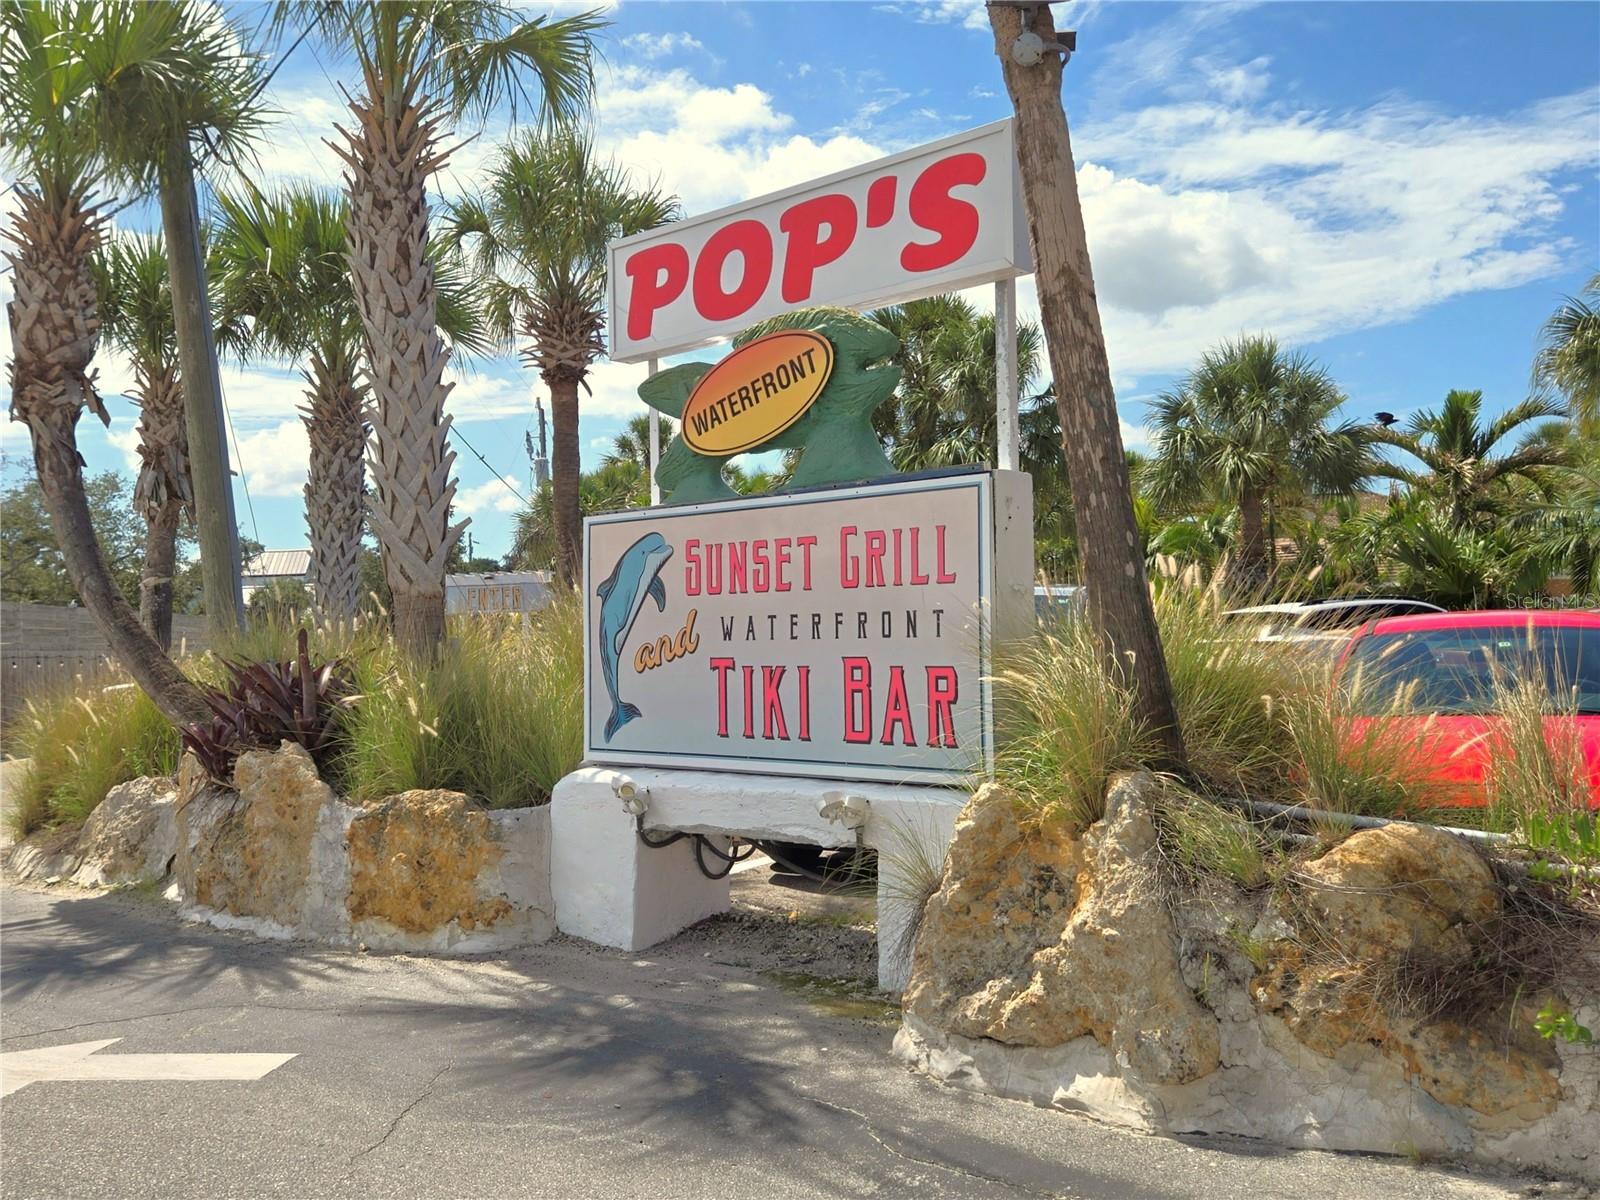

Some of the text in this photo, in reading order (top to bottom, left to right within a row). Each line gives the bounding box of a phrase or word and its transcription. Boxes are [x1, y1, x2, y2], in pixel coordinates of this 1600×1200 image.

[625, 152, 987, 341] POP'S
[690, 348, 818, 437] WATERFRONT
[467, 586, 521, 610] ENTER
[720, 609, 945, 642] WATERFRONT
[633, 608, 700, 674] and
[709, 656, 959, 749] TIKI BAR
